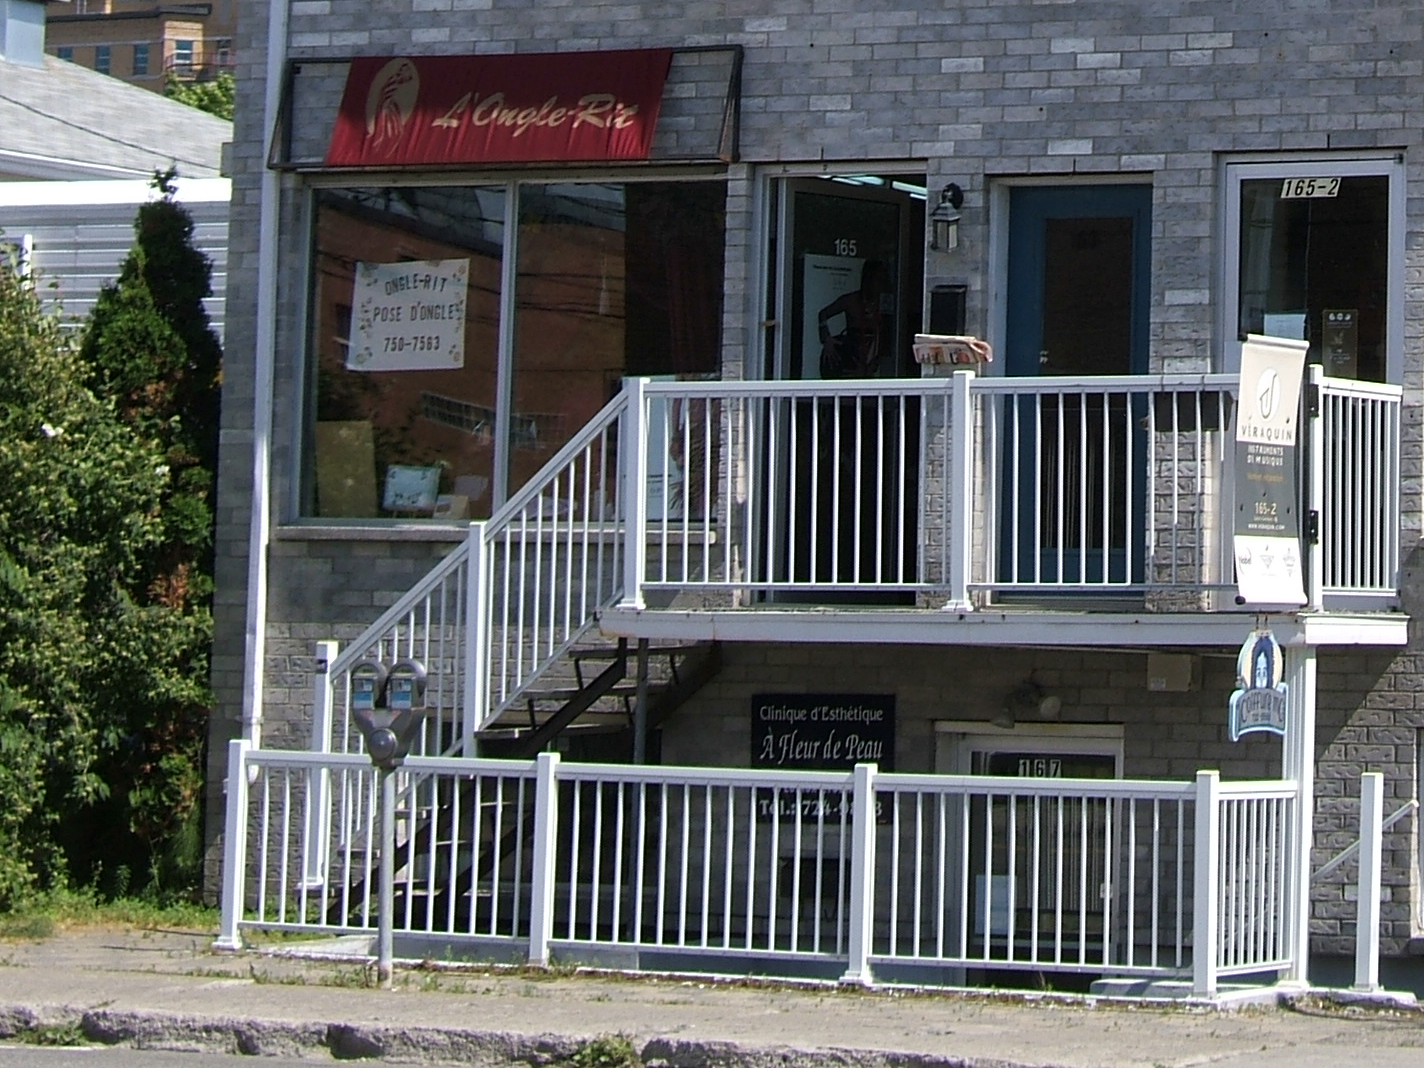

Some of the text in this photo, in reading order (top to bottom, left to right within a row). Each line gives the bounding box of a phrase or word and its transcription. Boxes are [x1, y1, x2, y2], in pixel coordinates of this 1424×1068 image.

[1285, 178, 1339, 196] 165-2
[834, 238, 857, 256] 165
[384, 273, 447, 296] ONGLE-RIT
[373, 306, 402, 323] POSE
[1255, 501, 1277, 515] 165-2
[759, 705, 883, 725] Clinique d'Esthétique
[778, 729, 821, 765] Fleur
[822, 729, 842, 759] de
[845, 734, 883, 760] Peau
[1021, 760, 1060, 777] 167
